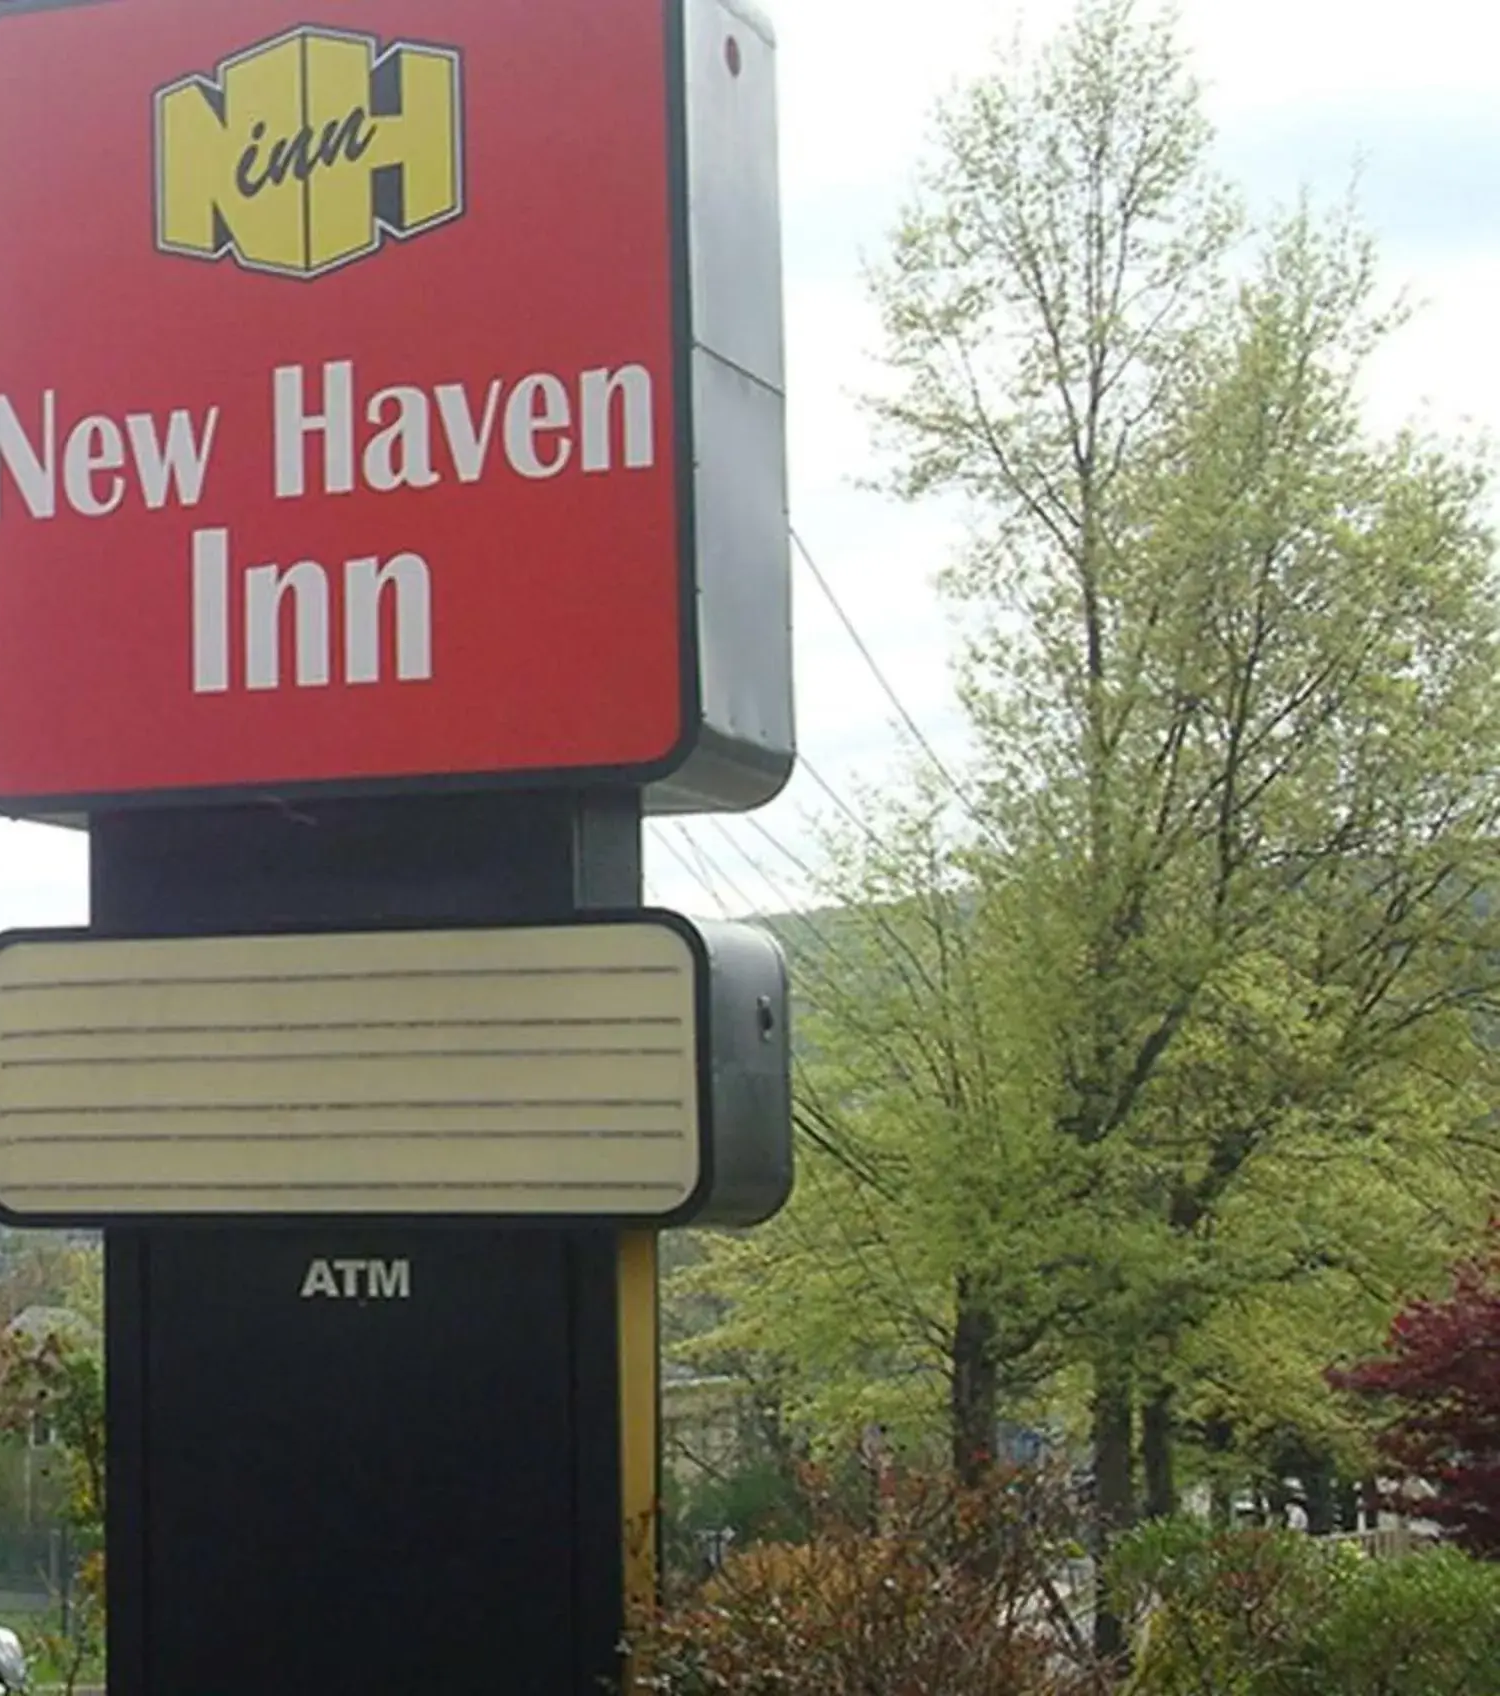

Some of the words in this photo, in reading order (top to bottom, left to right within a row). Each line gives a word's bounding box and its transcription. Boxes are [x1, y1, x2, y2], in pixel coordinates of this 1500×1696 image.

[235, 106, 377, 198] inn
[273, 360, 655, 499] Haven
[192, 527, 433, 693] Inn
[300, 1258, 411, 1298] ATM
